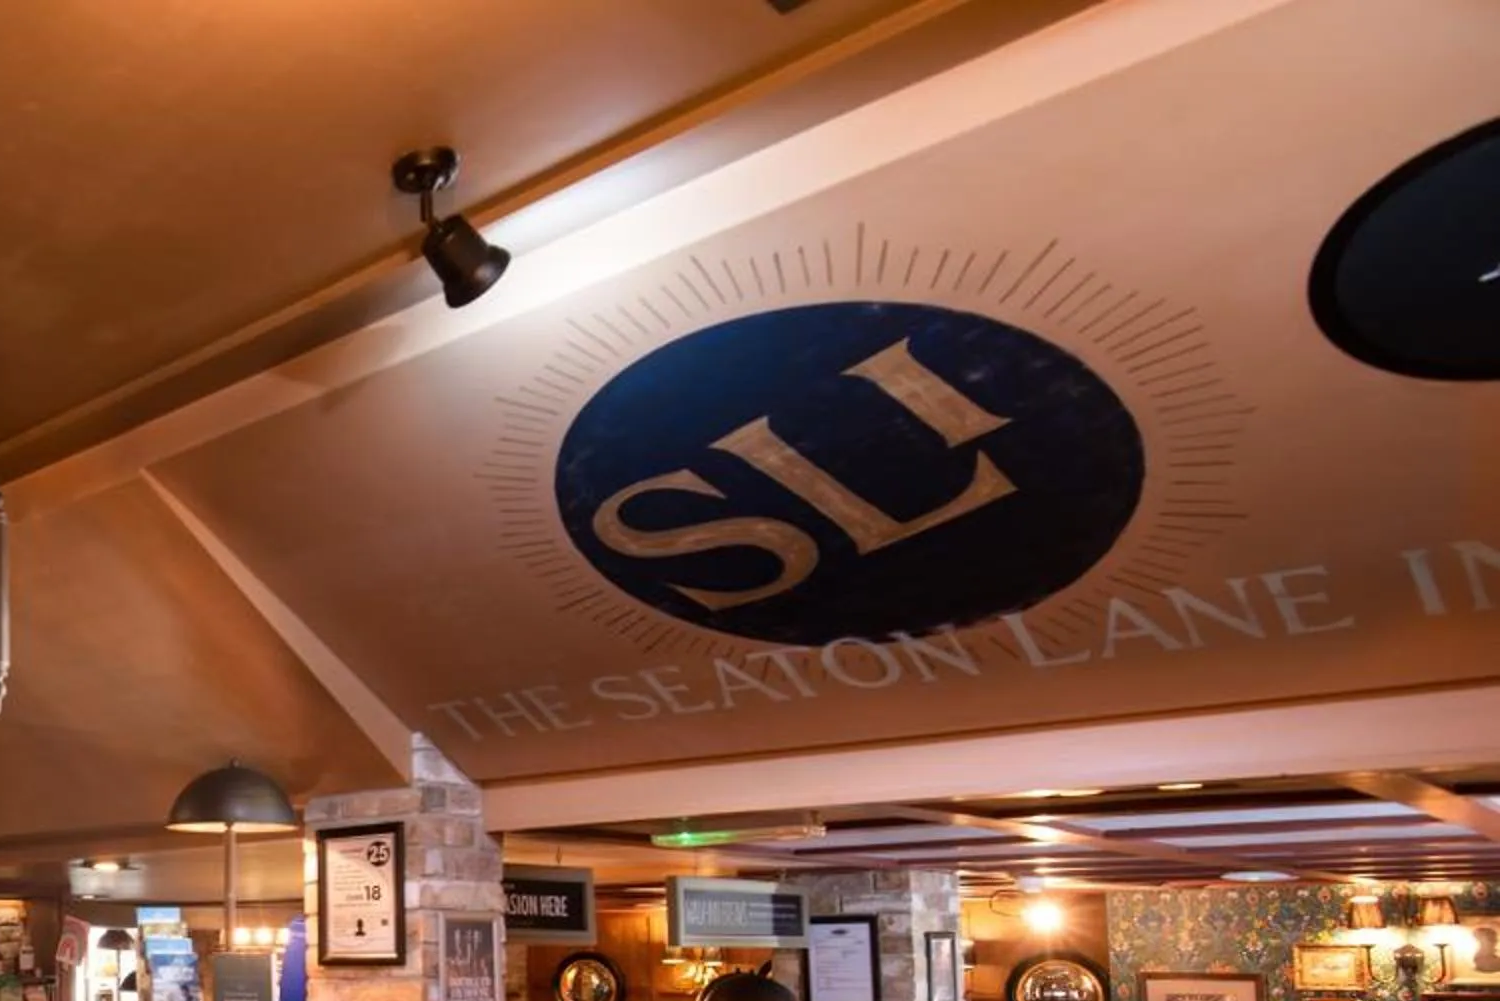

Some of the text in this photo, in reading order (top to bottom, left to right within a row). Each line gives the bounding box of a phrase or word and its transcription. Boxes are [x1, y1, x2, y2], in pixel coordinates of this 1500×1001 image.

[592, 336, 1019, 612] SLI
[427, 684, 594, 742] THE
[592, 623, 982, 721] SEATON
[1000, 564, 1356, 668] LANE
[369, 845, 389, 862] 25
[364, 885, 382, 901] 18
[540, 895, 570, 917] HERE
